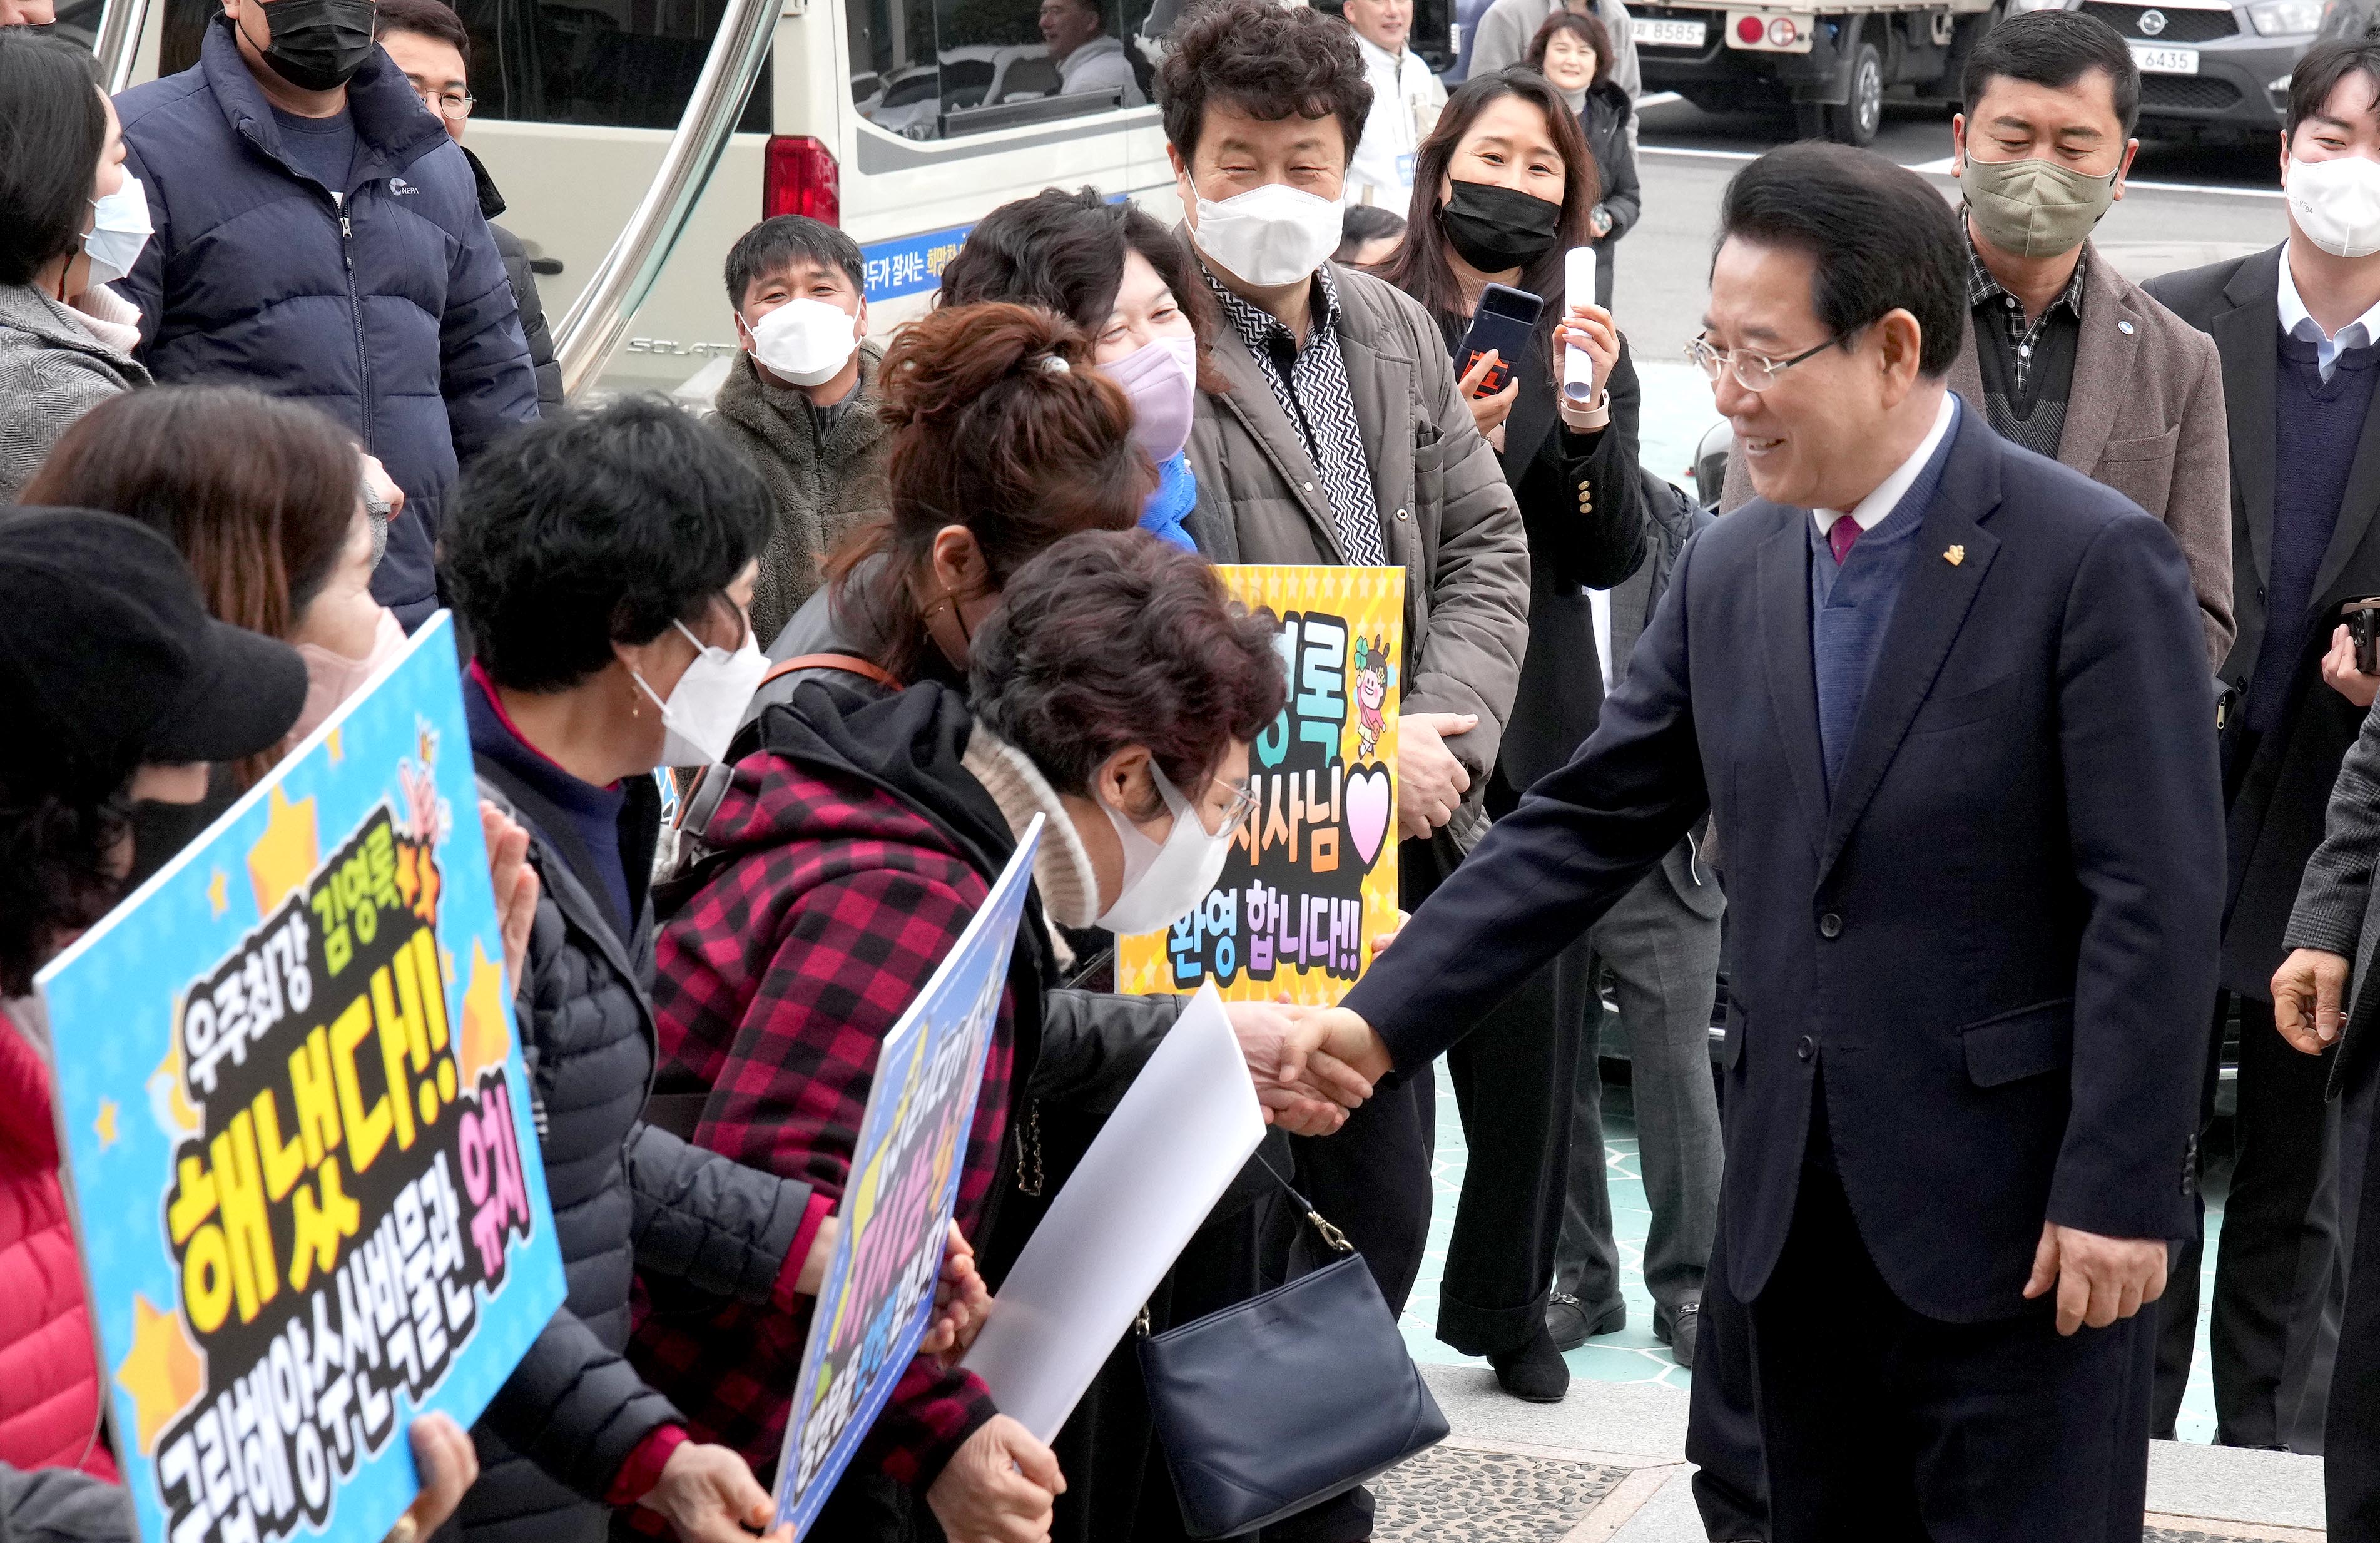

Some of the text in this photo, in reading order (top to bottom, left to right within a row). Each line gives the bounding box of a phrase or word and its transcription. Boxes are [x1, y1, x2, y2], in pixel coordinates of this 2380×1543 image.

[1654, 24, 1695, 41] 8585
[2145, 53, 2188, 69] 6435
[2299, 200, 2313, 214] KF94
[892, 251, 925, 287] 잘사는
[185, 821, 401, 1093] 우주최강 김영록
[1170, 878, 1360, 979] 환영 합니다!!
[169, 926, 457, 1333] 해냈다!!
[459, 1083, 529, 1278] 유치
